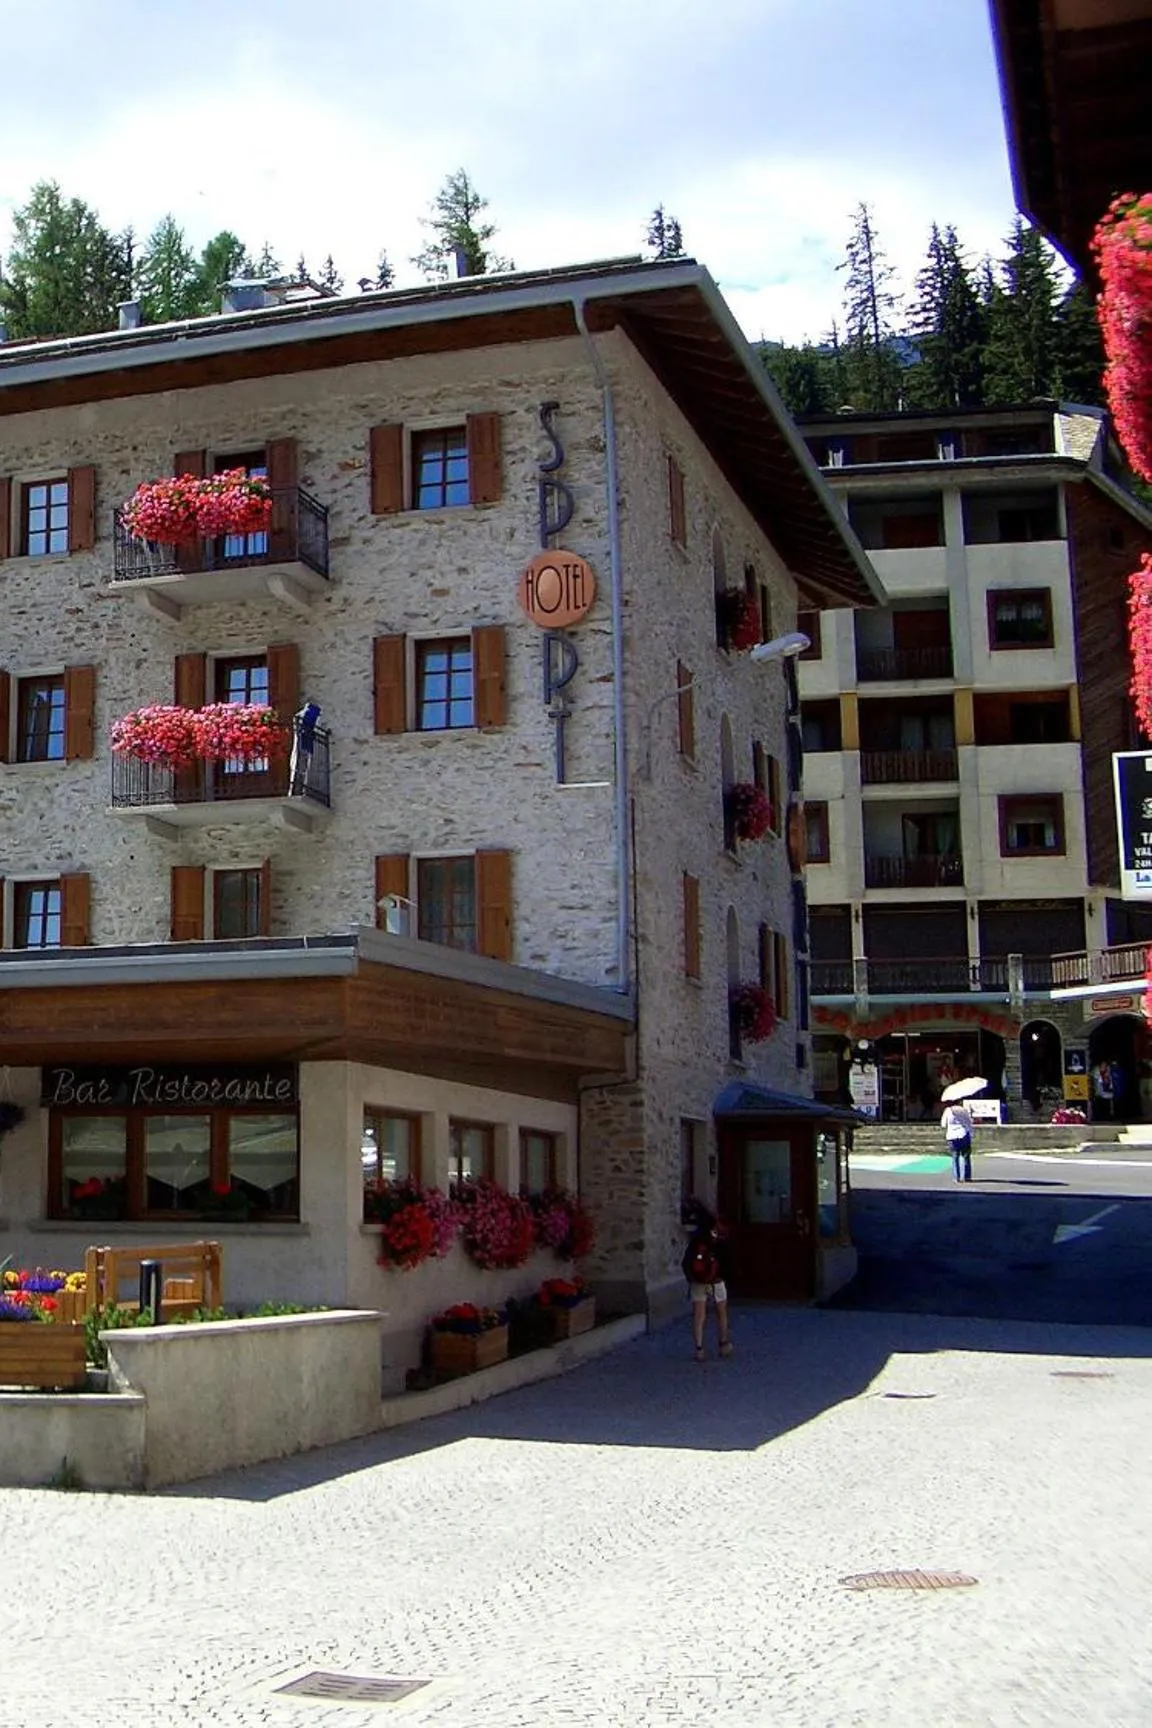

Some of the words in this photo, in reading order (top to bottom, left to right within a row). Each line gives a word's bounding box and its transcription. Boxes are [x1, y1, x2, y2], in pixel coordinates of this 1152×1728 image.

[526, 564, 587, 614] HOTEL
[51, 1067, 113, 1105] Bar
[129, 1067, 292, 1105] Ristorante
